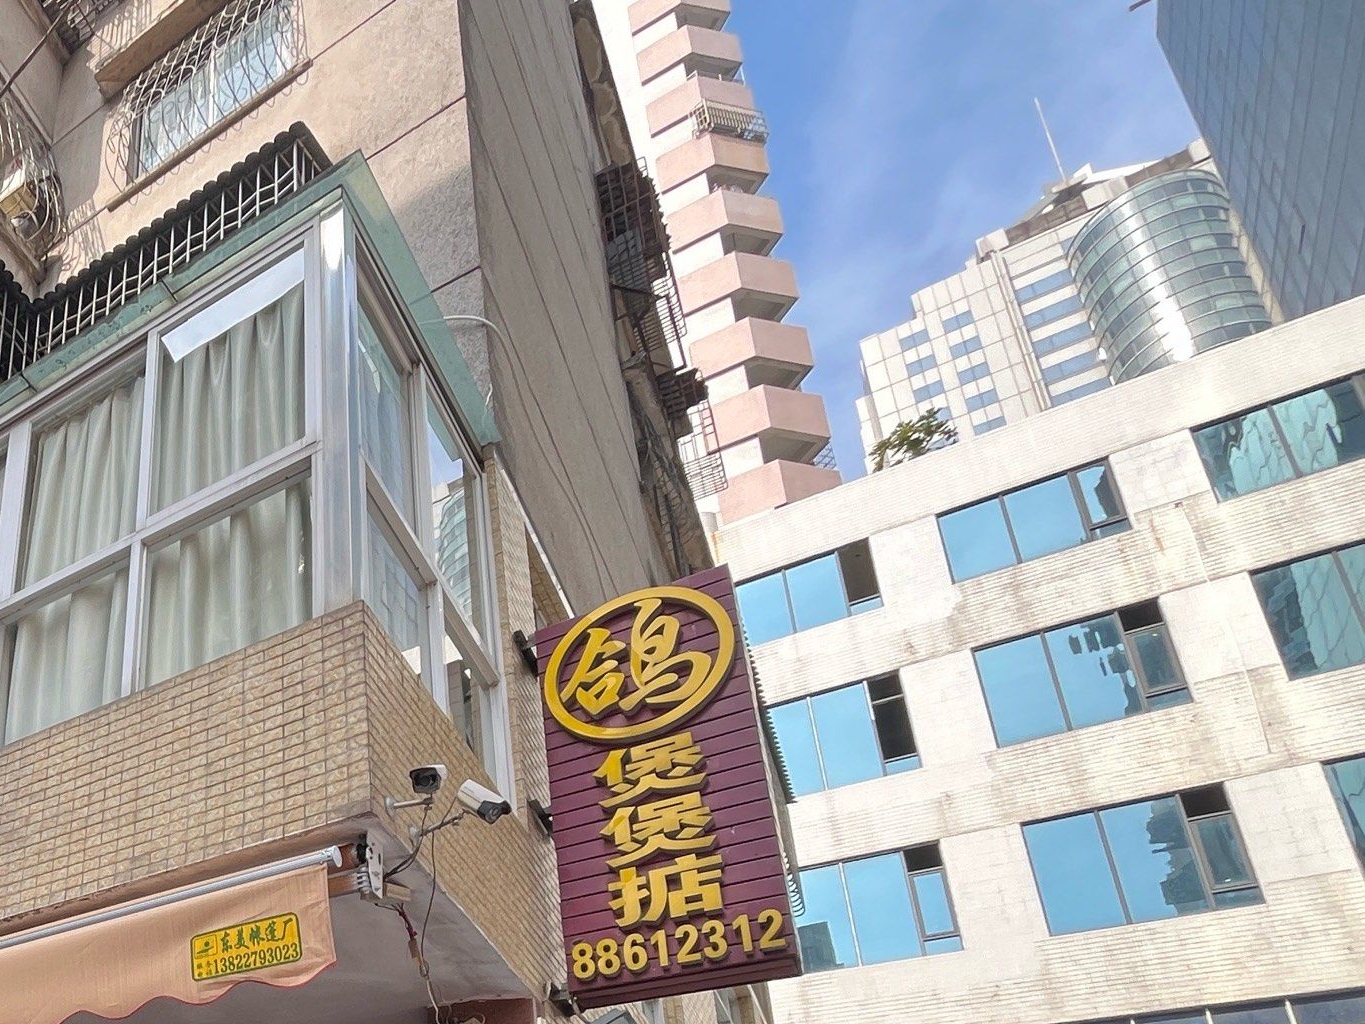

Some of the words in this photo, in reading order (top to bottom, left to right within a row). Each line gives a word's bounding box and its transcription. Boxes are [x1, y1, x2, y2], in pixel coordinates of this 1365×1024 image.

[560, 598, 716, 718] 鸽
[592, 730, 723, 929] 煲煲掂
[213, 942, 299, 974] 13822793023
[571, 909, 789, 982] 88612312
